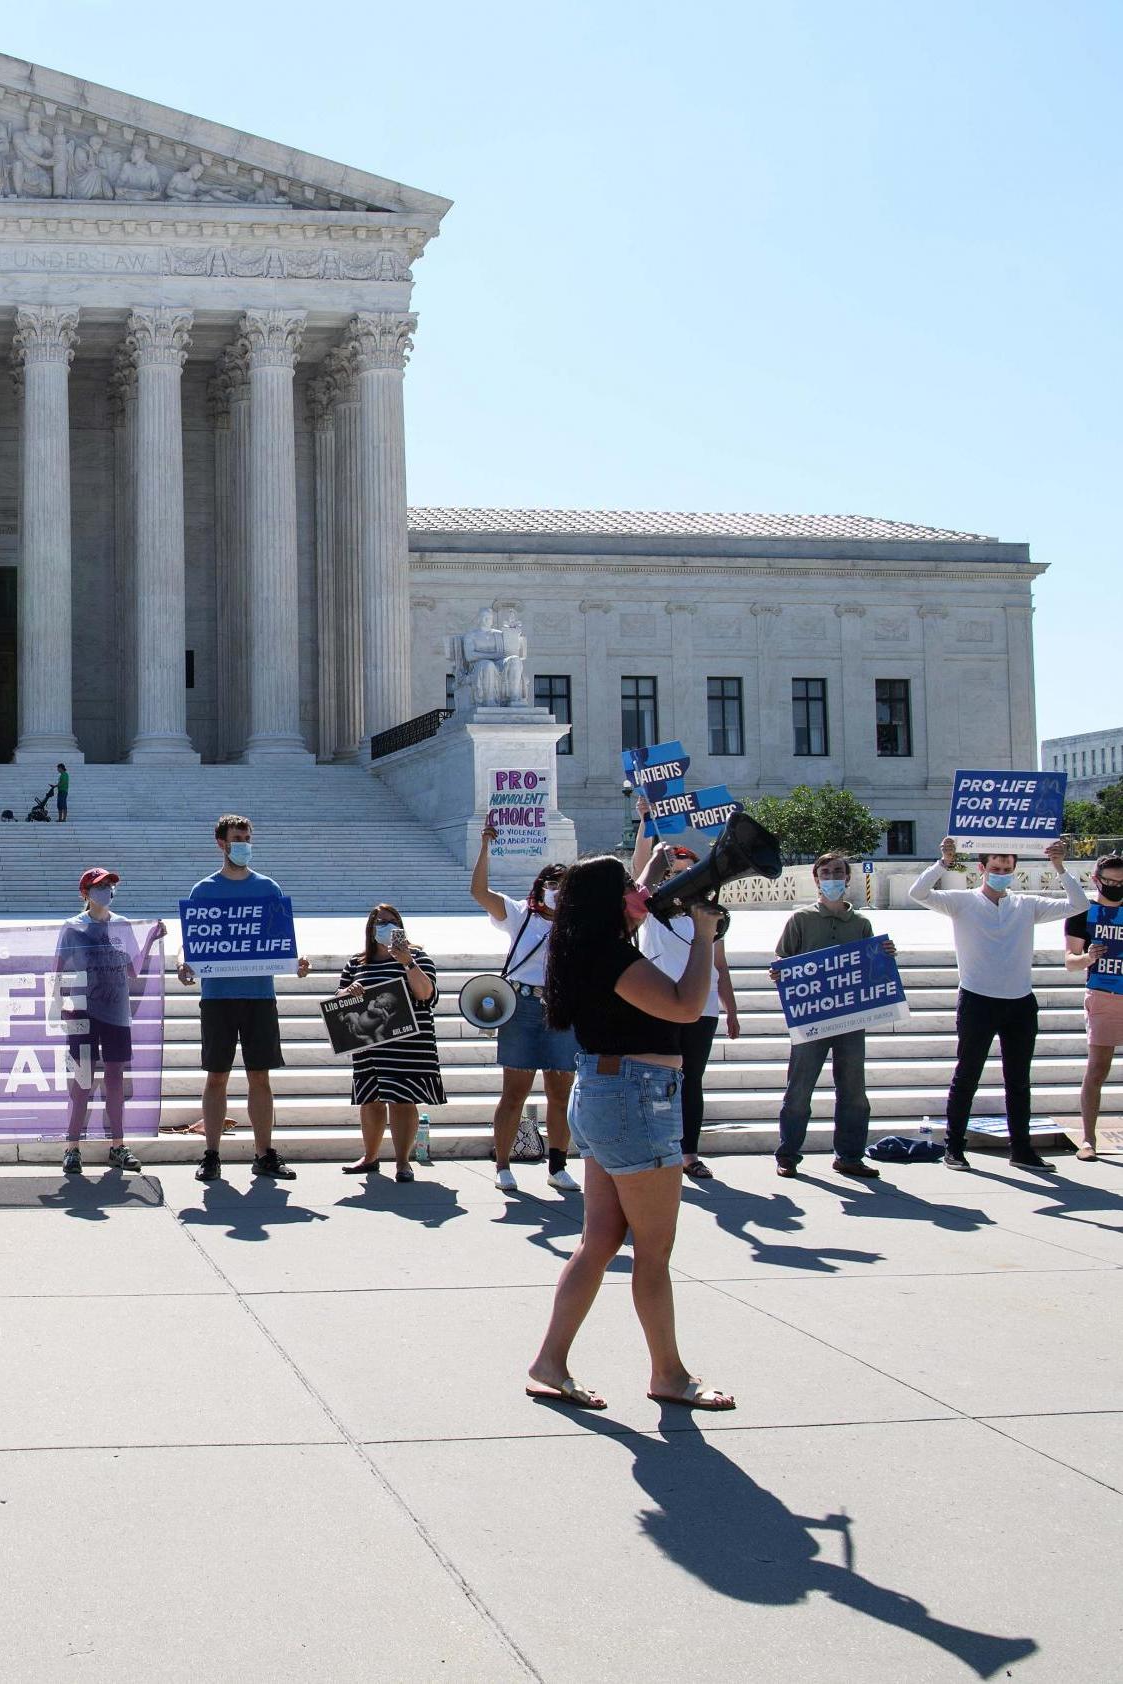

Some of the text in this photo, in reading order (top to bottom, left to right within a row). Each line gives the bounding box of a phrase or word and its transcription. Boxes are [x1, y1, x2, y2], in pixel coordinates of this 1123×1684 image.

[13, 249, 92, 268] UNDER
[102, 251, 148, 270] LAW
[496, 771, 546, 791] PRO-
[958, 779, 1037, 793] PRO-LIFE
[489, 793, 549, 806] NONVIOLENT
[956, 797, 1032, 811] FOR THE
[489, 807, 545, 828] CHOICE
[955, 815, 1057, 830] WHOLE LIFE
[185, 906, 263, 919] PRO-LIFE
[187, 923, 261, 936] FOR THE
[189, 939, 292, 954] WHOLE LIFE
[780, 950, 861, 983] PRO-LIFE
[785, 970, 862, 1001] FOR THE
[789, 981, 897, 1018] WHOLE LIFE
